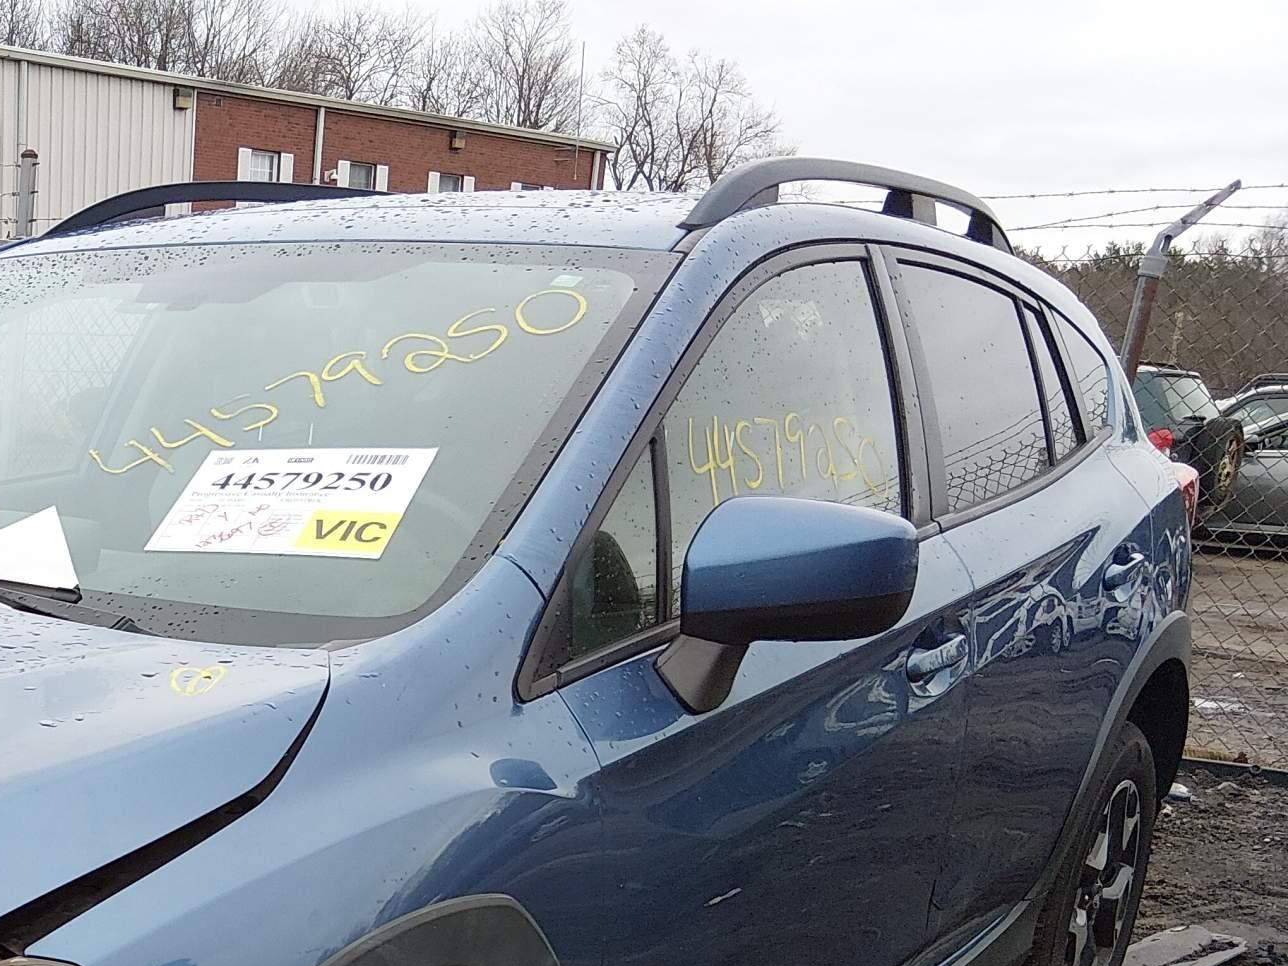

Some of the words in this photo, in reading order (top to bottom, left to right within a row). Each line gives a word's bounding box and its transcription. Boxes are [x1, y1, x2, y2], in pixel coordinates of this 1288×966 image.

[88, 288, 588, 474] 44579250
[211, 471, 393, 492] 44579250
[688, 411, 888, 505] 44579250
[314, 518, 387, 543] VIC
